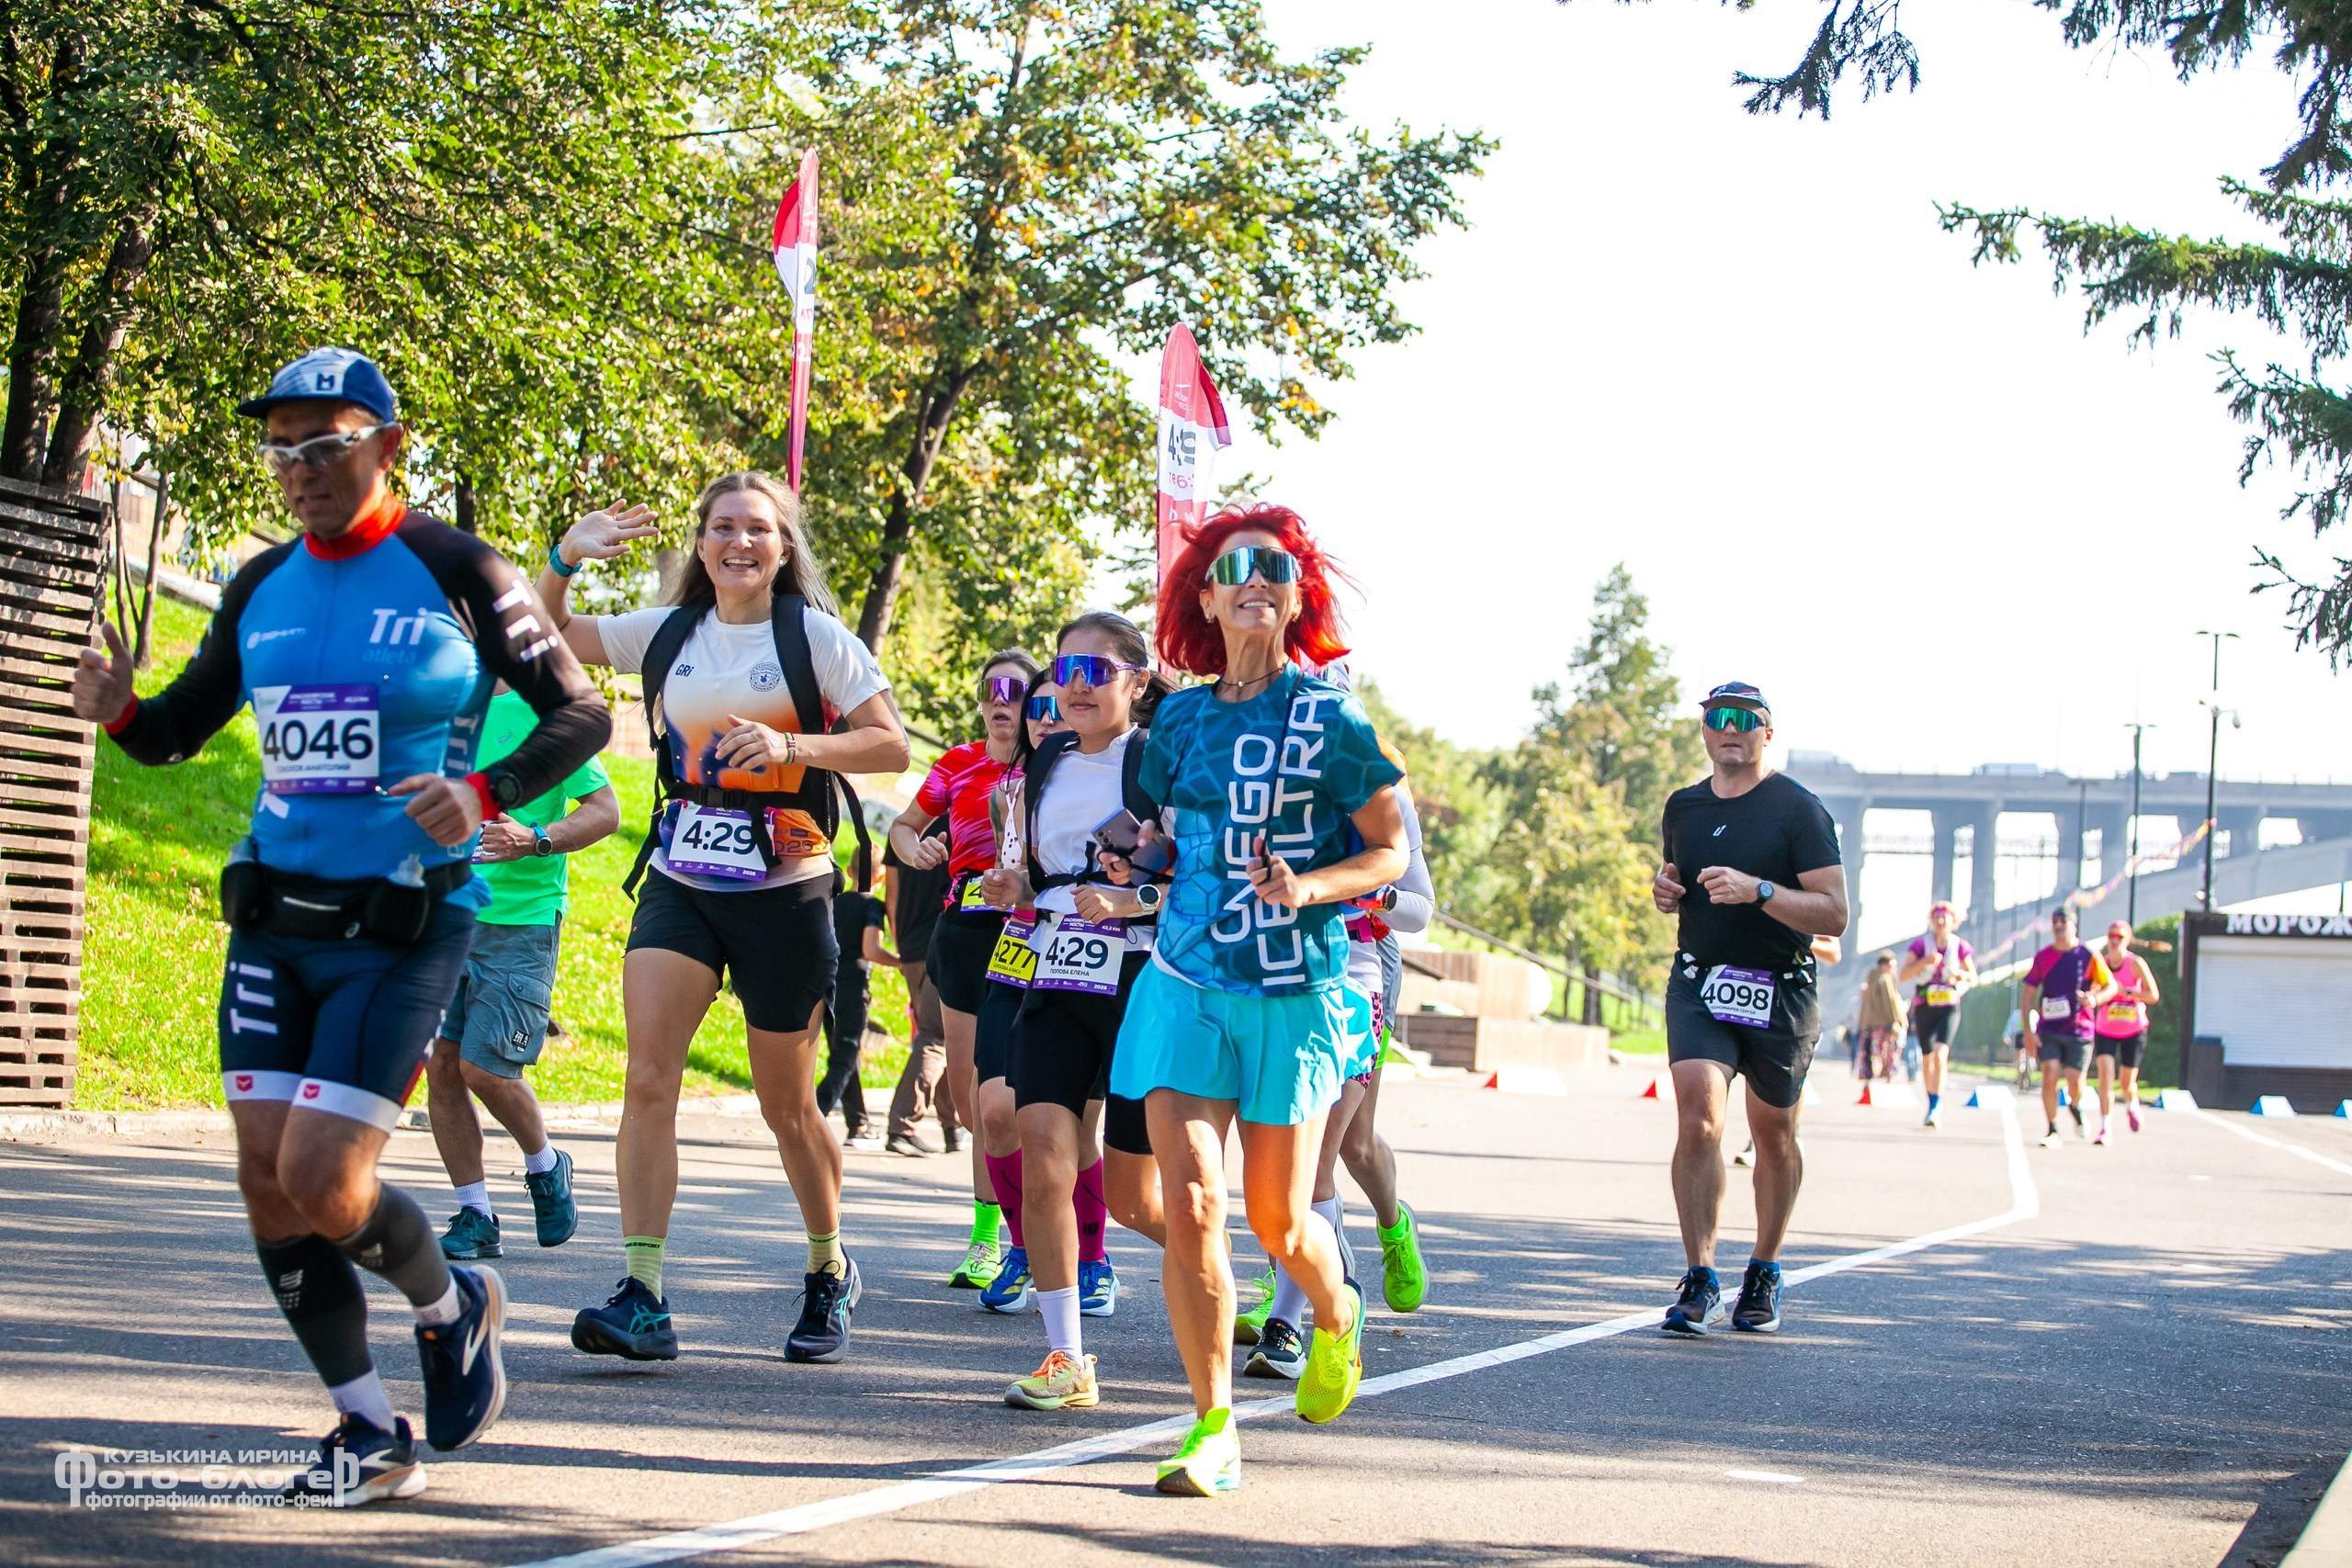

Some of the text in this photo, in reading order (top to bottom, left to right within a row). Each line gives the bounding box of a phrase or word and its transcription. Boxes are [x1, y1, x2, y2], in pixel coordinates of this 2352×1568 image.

[369, 607, 426, 645] Tri
[492, 578, 559, 662] Tri
[363, 647, 417, 663] atleta
[263, 717, 373, 761] 4046
[682, 819, 757, 855] 4:29
[1045, 936, 1109, 969] 4:29
[230, 961, 278, 1035] Tri
[1702, 983, 1770, 1011] 4098
